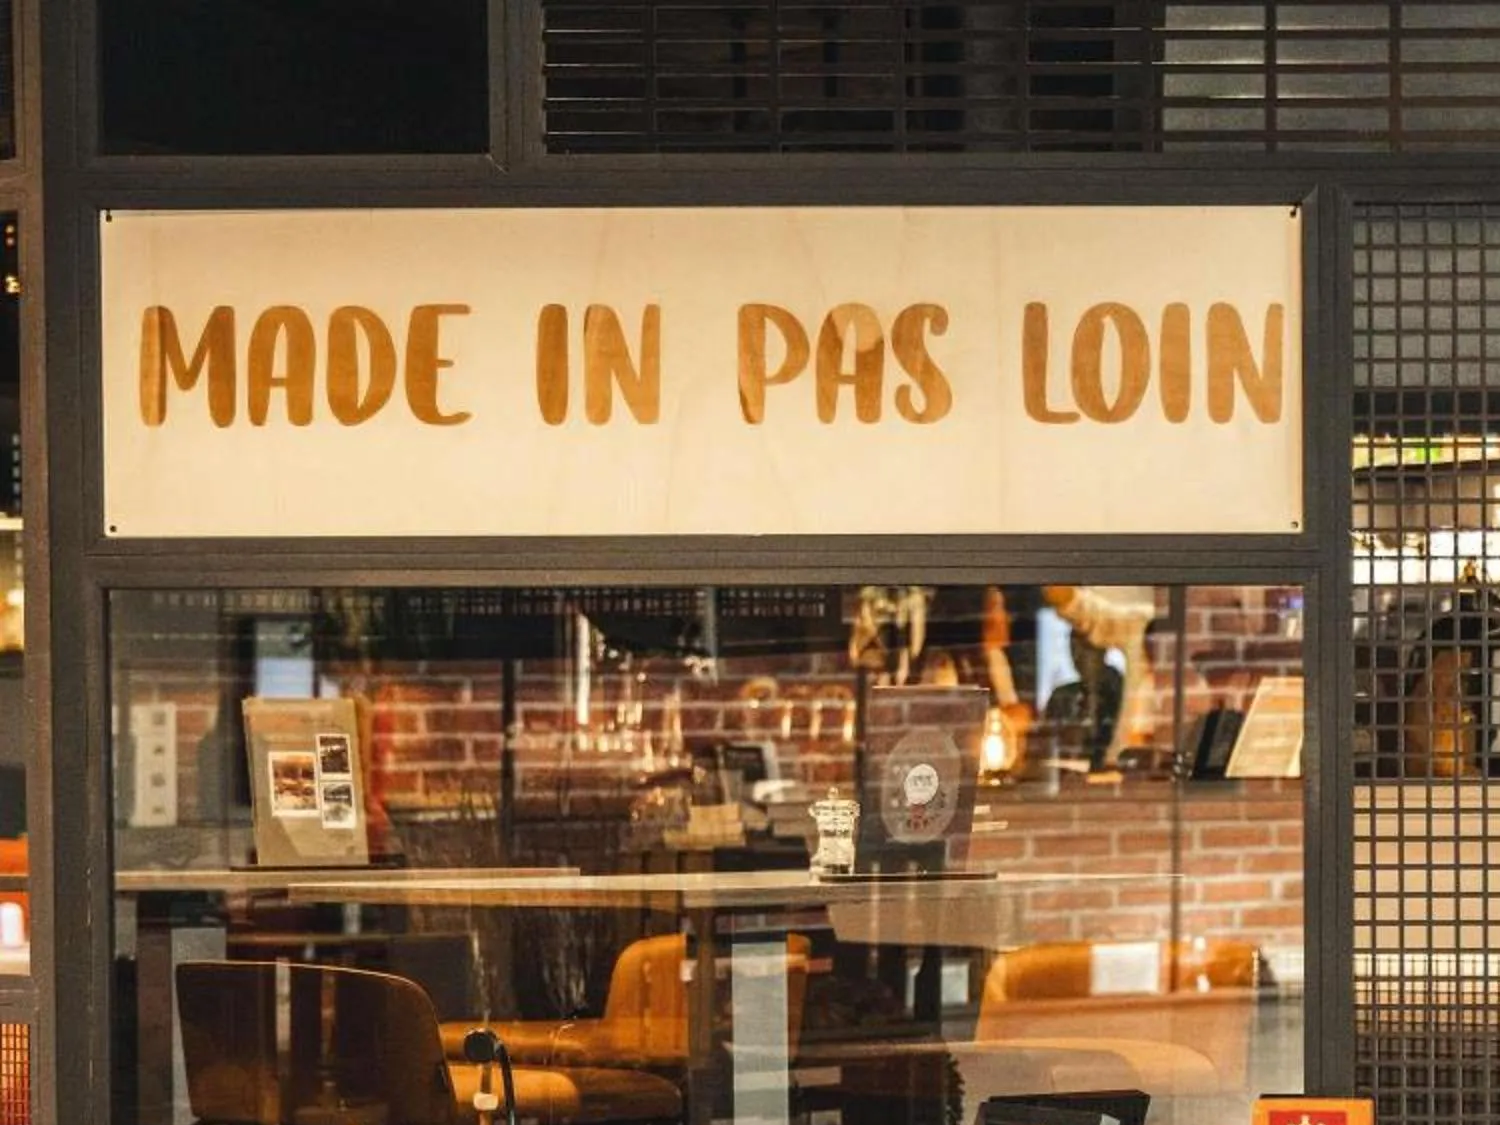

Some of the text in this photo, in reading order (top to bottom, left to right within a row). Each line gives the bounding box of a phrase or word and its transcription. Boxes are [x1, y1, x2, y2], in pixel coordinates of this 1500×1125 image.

[139, 301, 1284, 428] MADE IN PAS LOIN
